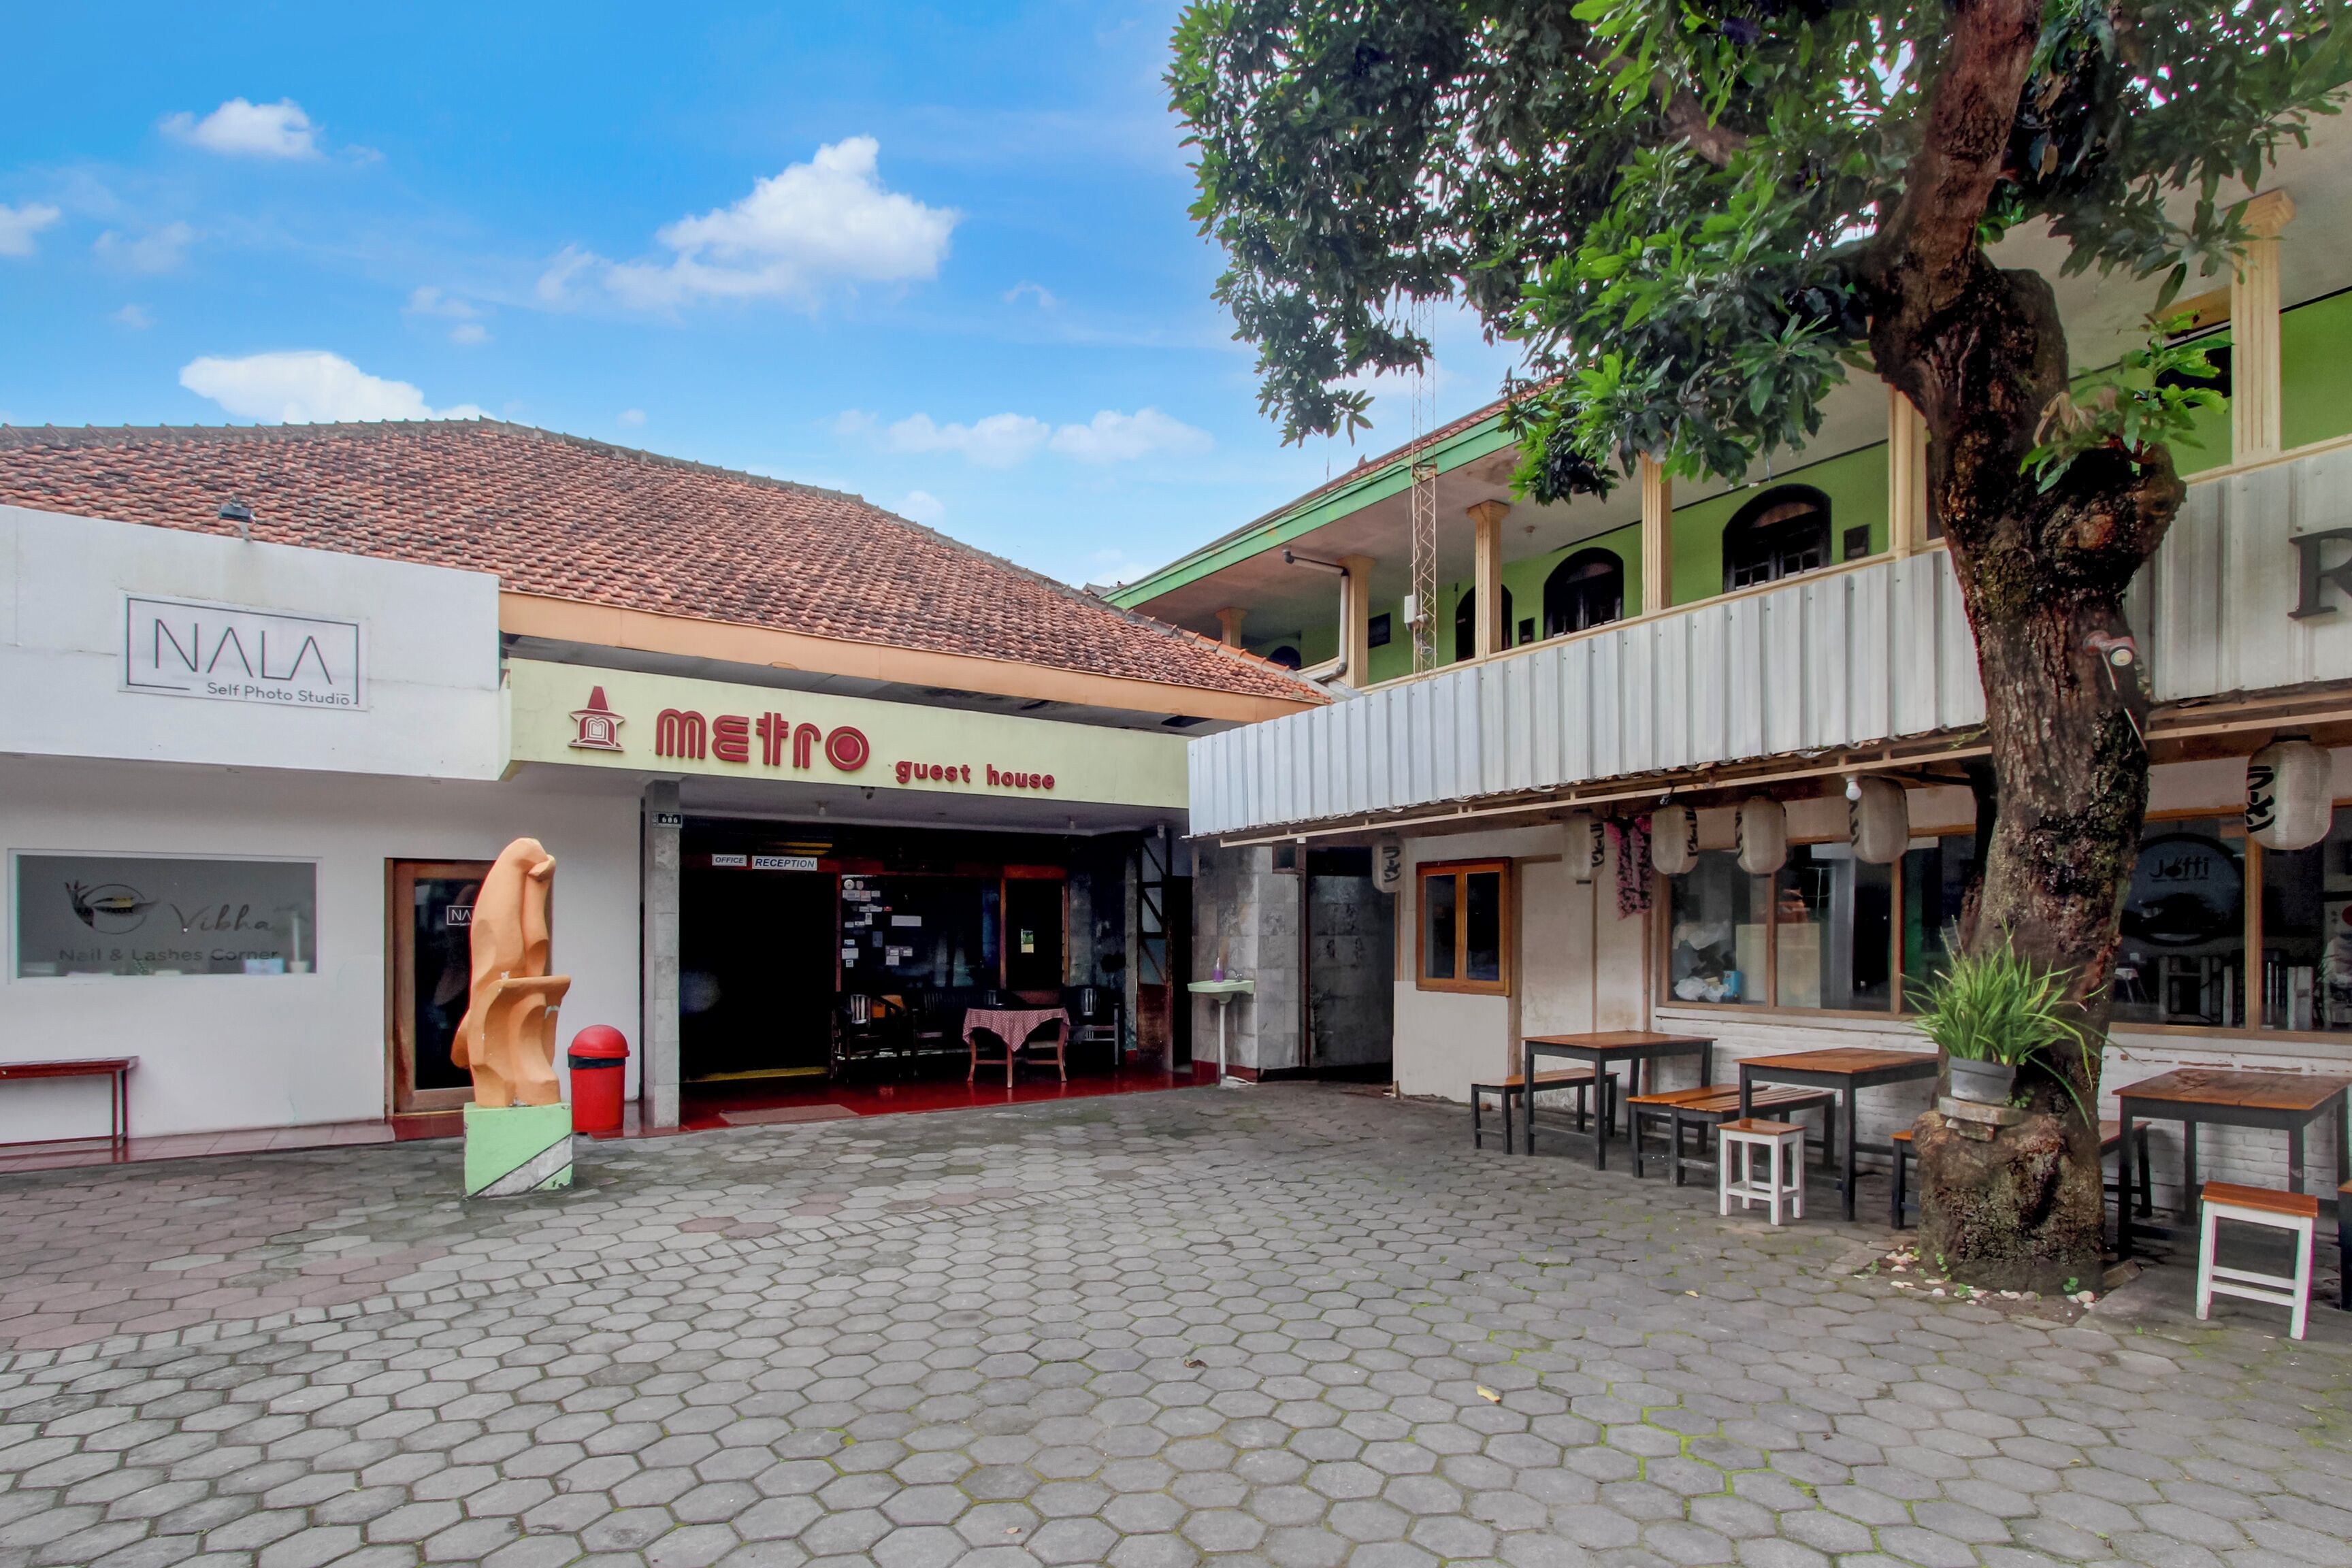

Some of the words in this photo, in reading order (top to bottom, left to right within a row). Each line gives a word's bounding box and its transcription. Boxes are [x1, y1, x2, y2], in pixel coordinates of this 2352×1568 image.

[154, 618, 333, 685] NALA
[207, 681, 240, 697] Self
[244, 685, 293, 701] Photo
[297, 689, 350, 706] Studio
[895, 760, 971, 785] guest
[986, 764, 1055, 789] house
[2246, 766, 2276, 834] ラーメン
[755, 858, 815, 868] RECEPTION
[1382, 846, 1401, 883] ラーメン
[170, 903, 274, 935] Vibha
[59, 949, 101, 961] Nail
[110, 949, 122, 960] &
[131, 949, 202, 961] Lashes
[210, 949, 279, 960] Corner
